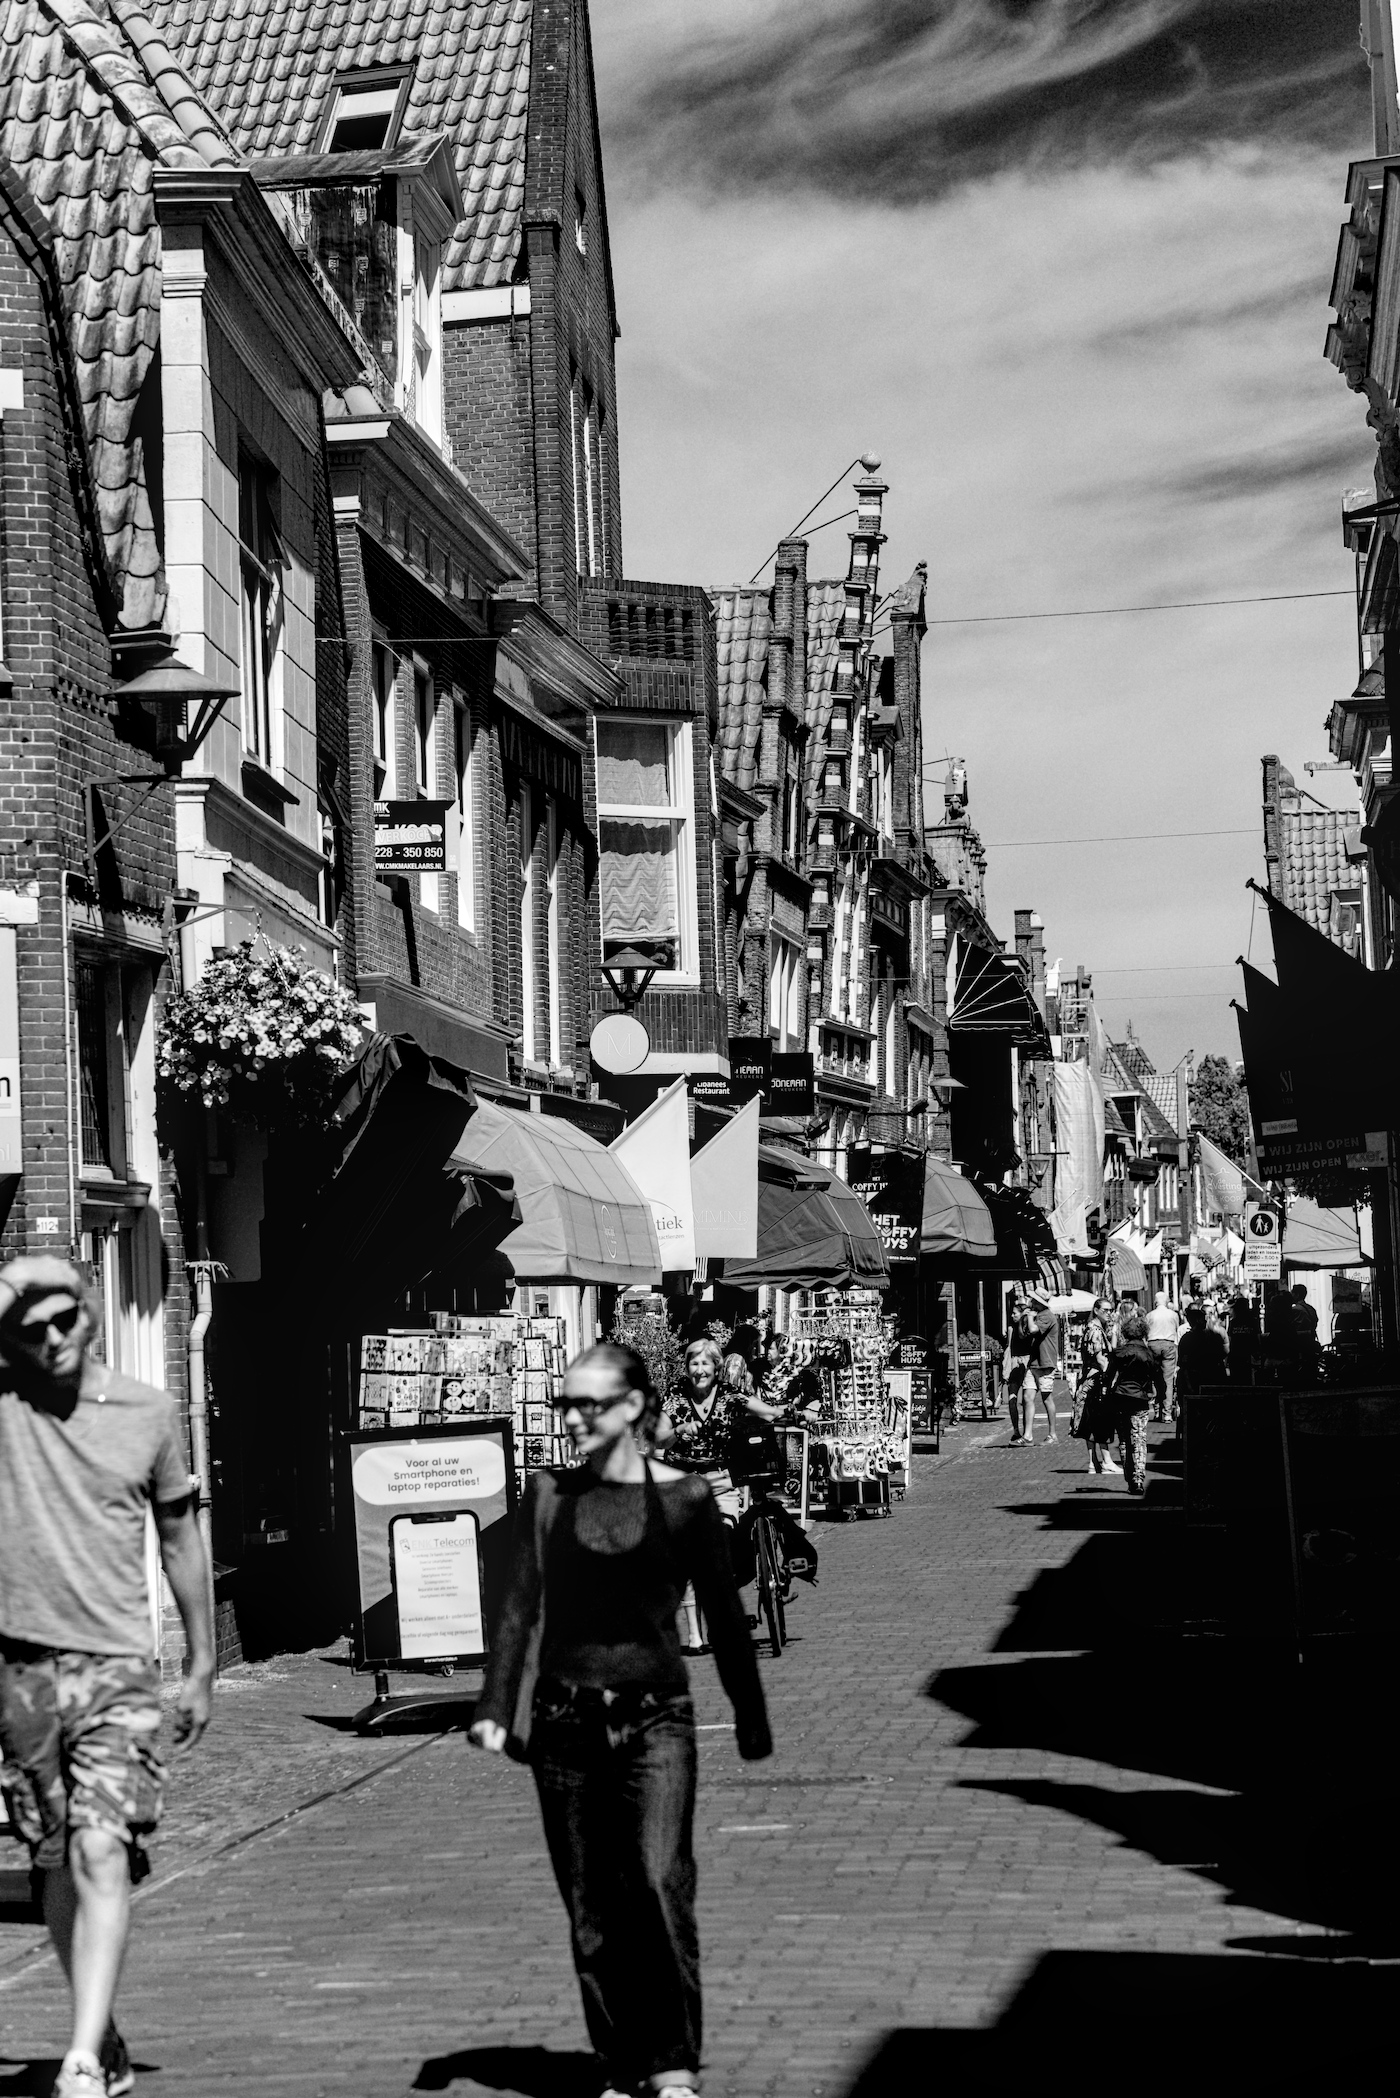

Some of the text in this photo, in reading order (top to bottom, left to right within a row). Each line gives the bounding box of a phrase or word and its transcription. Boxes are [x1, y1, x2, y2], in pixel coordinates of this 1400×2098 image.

[377, 828, 434, 844] VERKOCH
[403, 847, 422, 858] 350
[424, 847, 443, 858] 850
[1269, 1136, 1360, 1156] WIJ ZIJN OPEN
[1262, 1156, 1342, 1176] WIJ ZIJN OPEN
[852, 1183, 878, 1191] COFFY
[40, 1221, 55, 1231] 112
[656, 1216, 683, 1230] tiek
[872, 1214, 900, 1226] HET
[405, 1458, 428, 1468] Voor
[431, 1456, 442, 1466] al
[394, 1467, 473, 1481] Smartphone en
[388, 1477, 480, 1493] laptop reparaties!
[434, 1538, 474, 1547] Telecom
